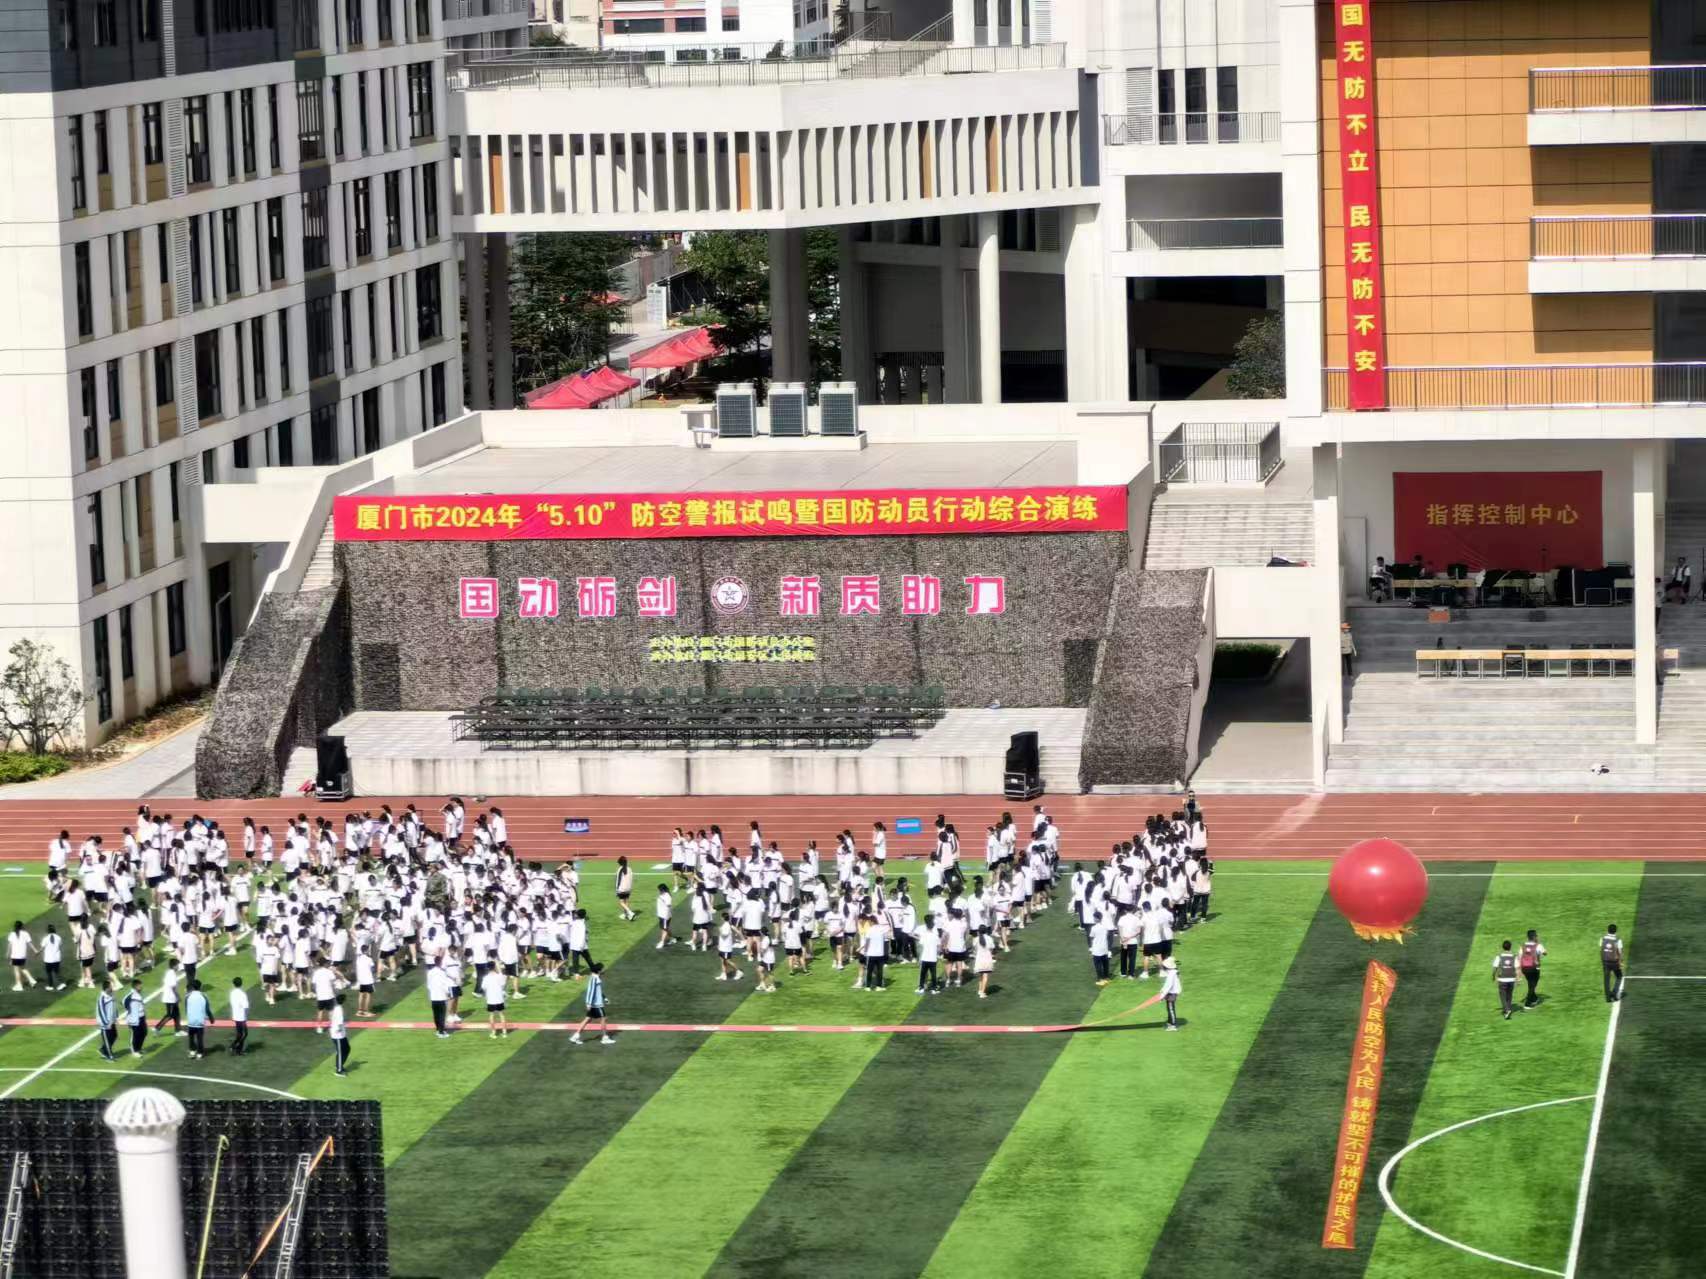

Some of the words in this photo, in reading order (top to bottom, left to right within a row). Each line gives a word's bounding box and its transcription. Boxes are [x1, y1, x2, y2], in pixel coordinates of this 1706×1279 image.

[1341, 4, 1369, 172] 国无防不立
[1350, 205, 1377, 372] 民无防不安
[1426, 503, 1579, 526] 指挥控制中心
[459, 576, 677, 618] 国动砺剑
[780, 574, 1006, 616] 新质助力
